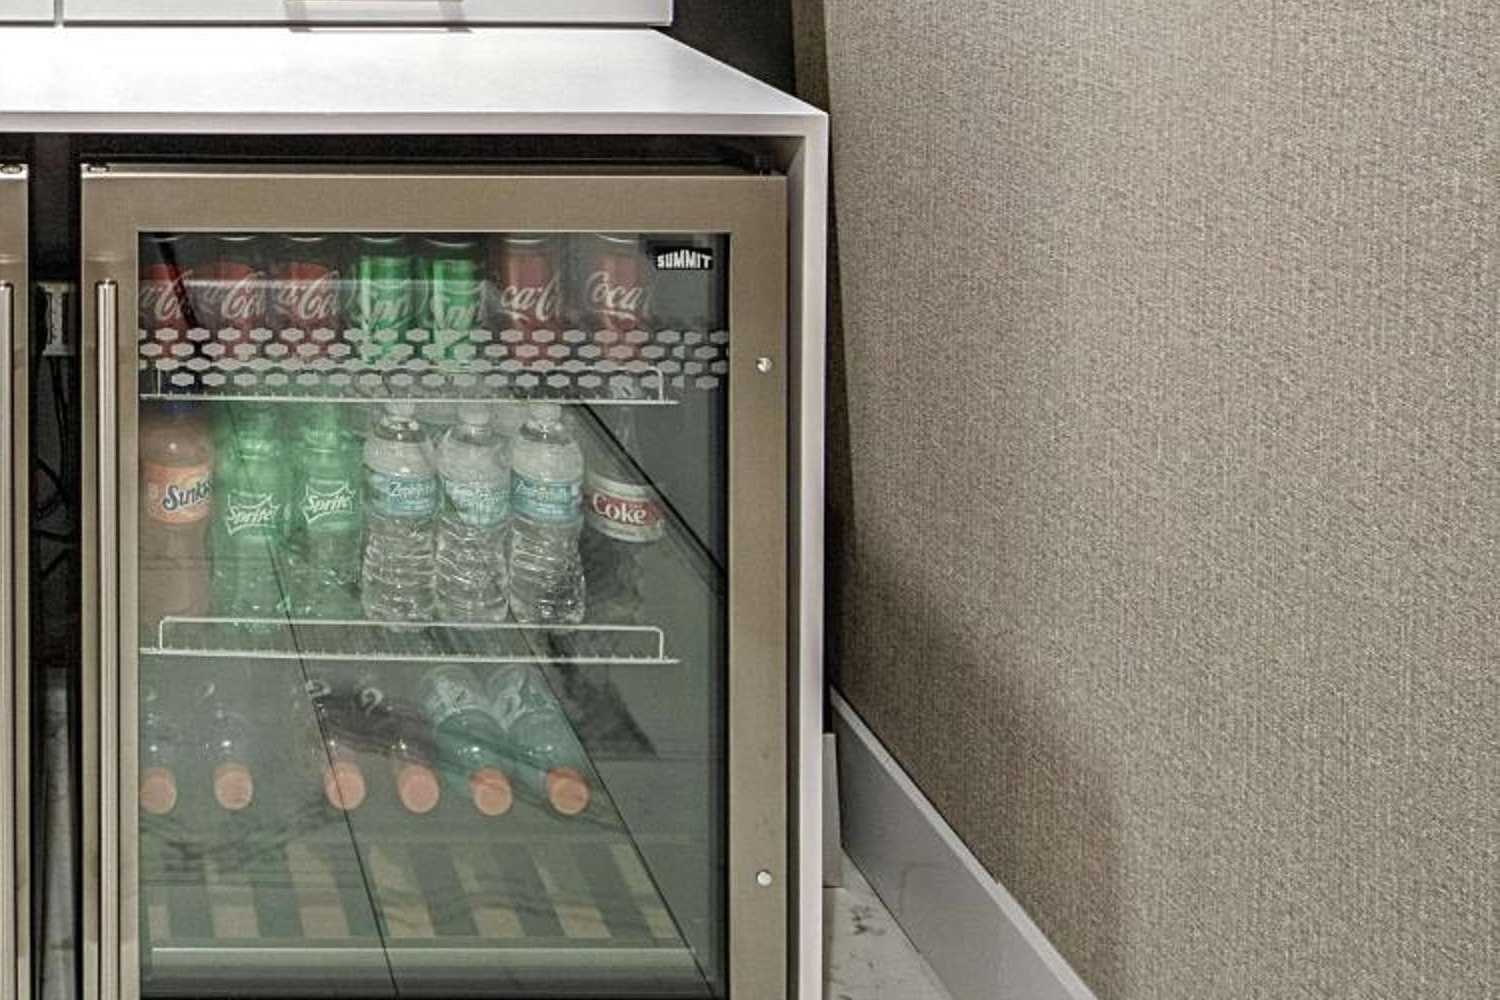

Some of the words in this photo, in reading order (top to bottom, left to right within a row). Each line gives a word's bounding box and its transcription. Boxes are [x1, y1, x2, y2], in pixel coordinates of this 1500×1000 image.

[656, 249, 713, 270] SUMMIT
[307, 496, 351, 515] Sprite
[593, 492, 647, 525] Coke
[228, 506, 276, 528] Sprite
